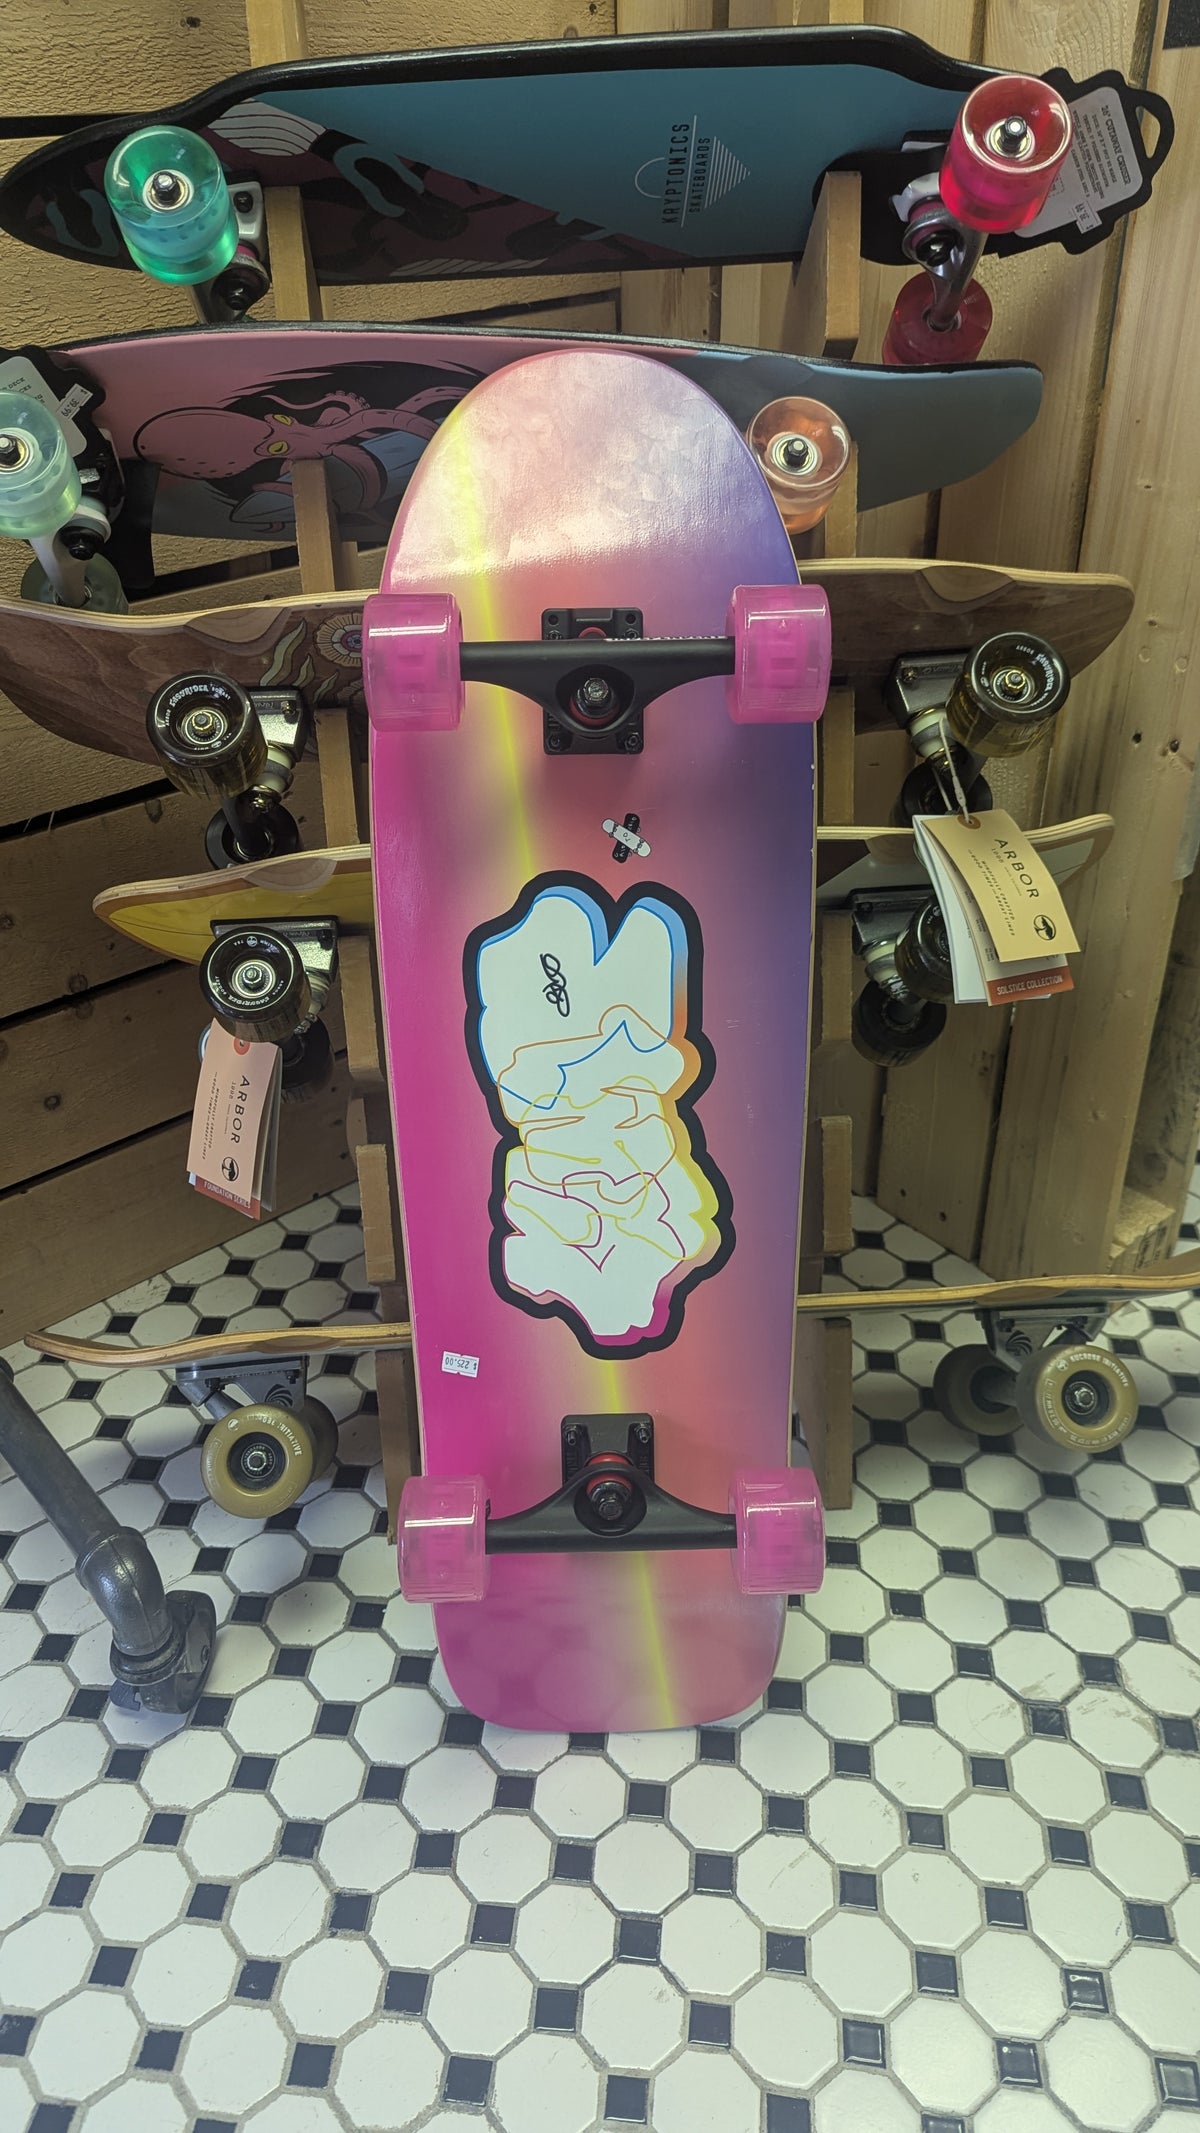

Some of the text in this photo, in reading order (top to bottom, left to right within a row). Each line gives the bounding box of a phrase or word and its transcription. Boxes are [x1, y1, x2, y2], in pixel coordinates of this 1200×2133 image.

[1105, 118, 1123, 155] CUTAWAY
[1116, 154, 1131, 185] CRUISER
[661, 123, 690, 224] KRYPTONICS
[689, 137, 711, 213] SKATEBOARDS
[169, 684, 209, 707] EASYRIDER
[994, 838, 1040, 899] ARBOR
[996, 974, 1065, 996] SOLSTICE COLLECTION
[230, 1074, 251, 1144] ARBOR
[203, 1180, 234, 1200] FOUNDATION
[445, 1356, 470, 1370] 225.00
[1102, 1357, 1129, 1387] INITIATIVE
[276, 1422, 303, 1456] INITIATIVE
